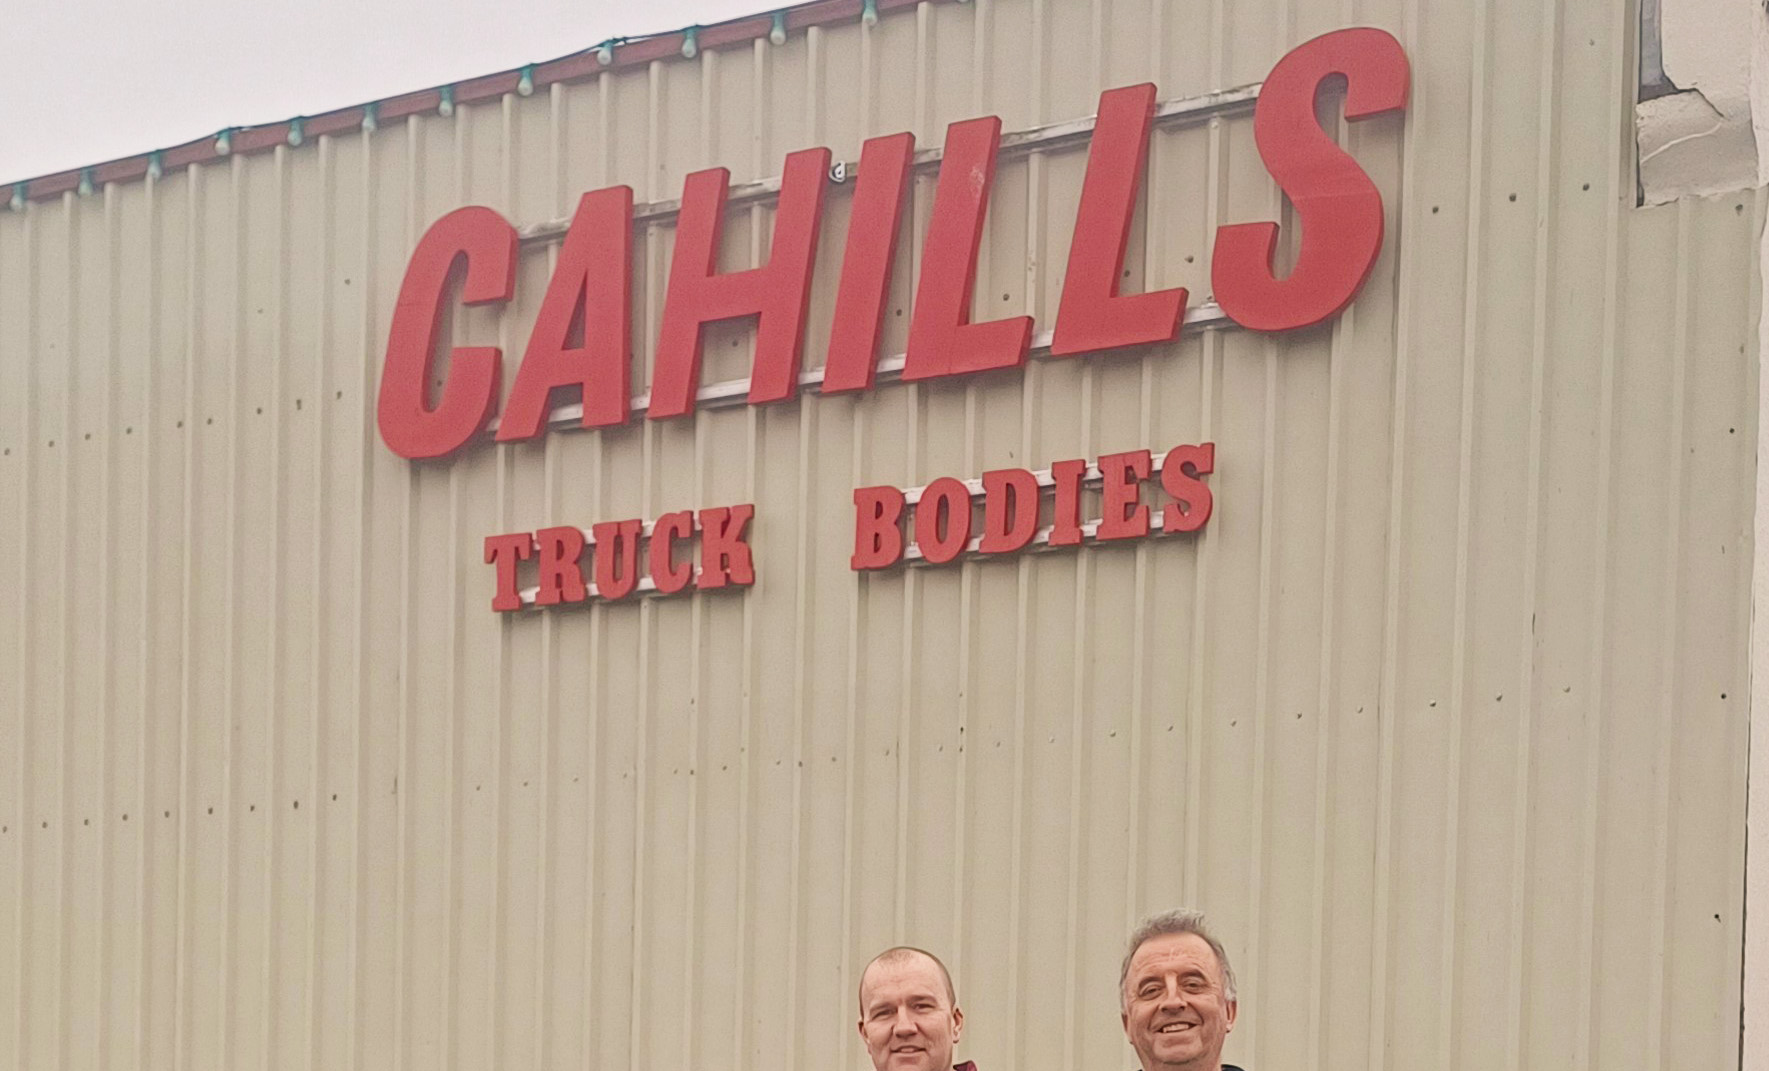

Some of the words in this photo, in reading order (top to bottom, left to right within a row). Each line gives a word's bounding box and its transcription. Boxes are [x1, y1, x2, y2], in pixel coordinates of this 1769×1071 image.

[377, 28, 1411, 459] CAHILLS
[485, 505, 756, 612] TRUCK
[850, 443, 1215, 571] BODIES
